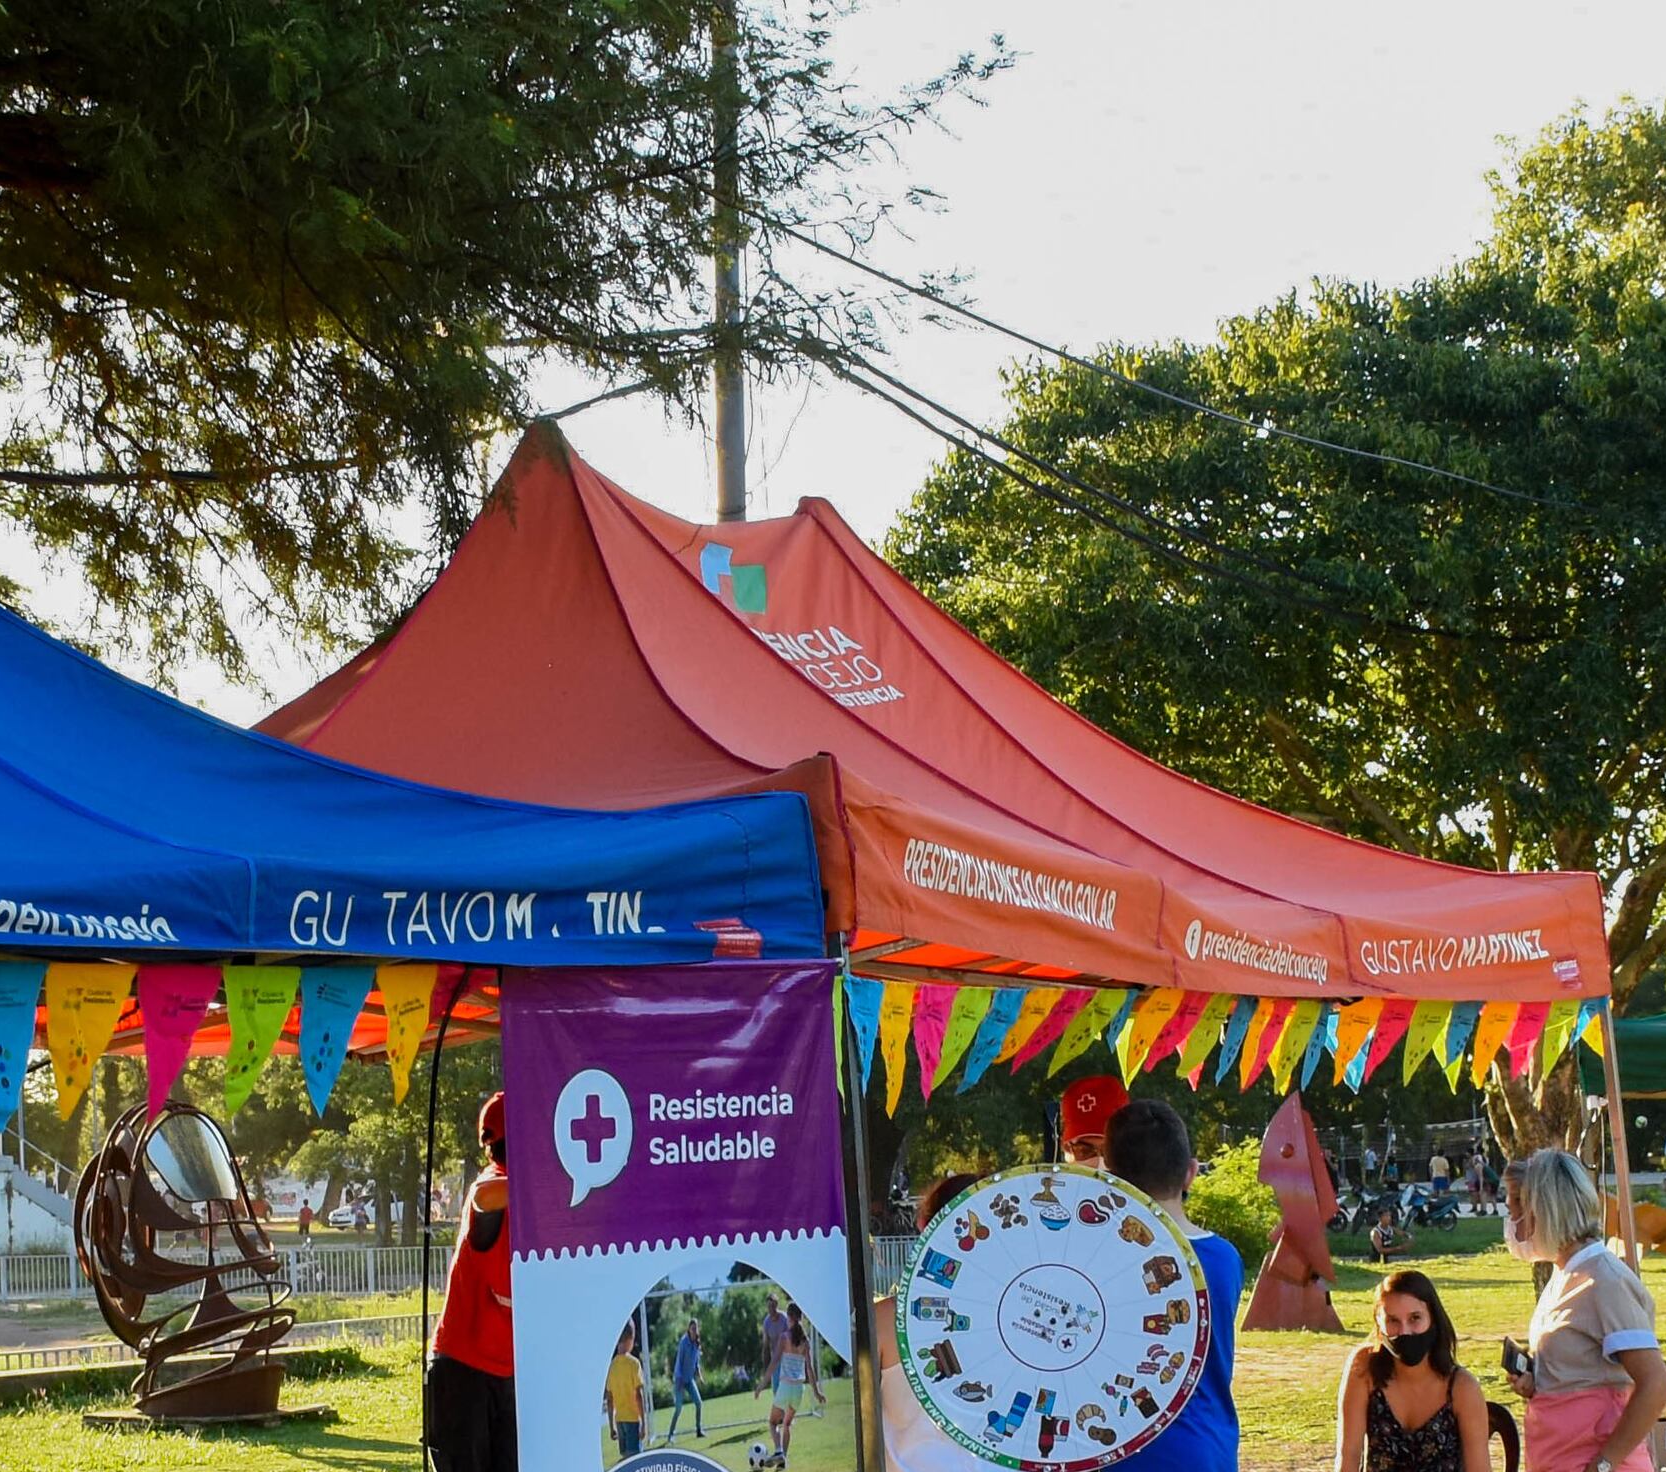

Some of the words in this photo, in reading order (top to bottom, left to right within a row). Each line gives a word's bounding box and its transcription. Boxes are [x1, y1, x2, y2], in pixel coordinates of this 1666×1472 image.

[290, 890, 494, 946] GUTAVO
[1202, 930, 1328, 986] presidenciadelconcejo
[649, 1085, 793, 1121] Resistencia
[649, 1130, 776, 1165] Saludable
